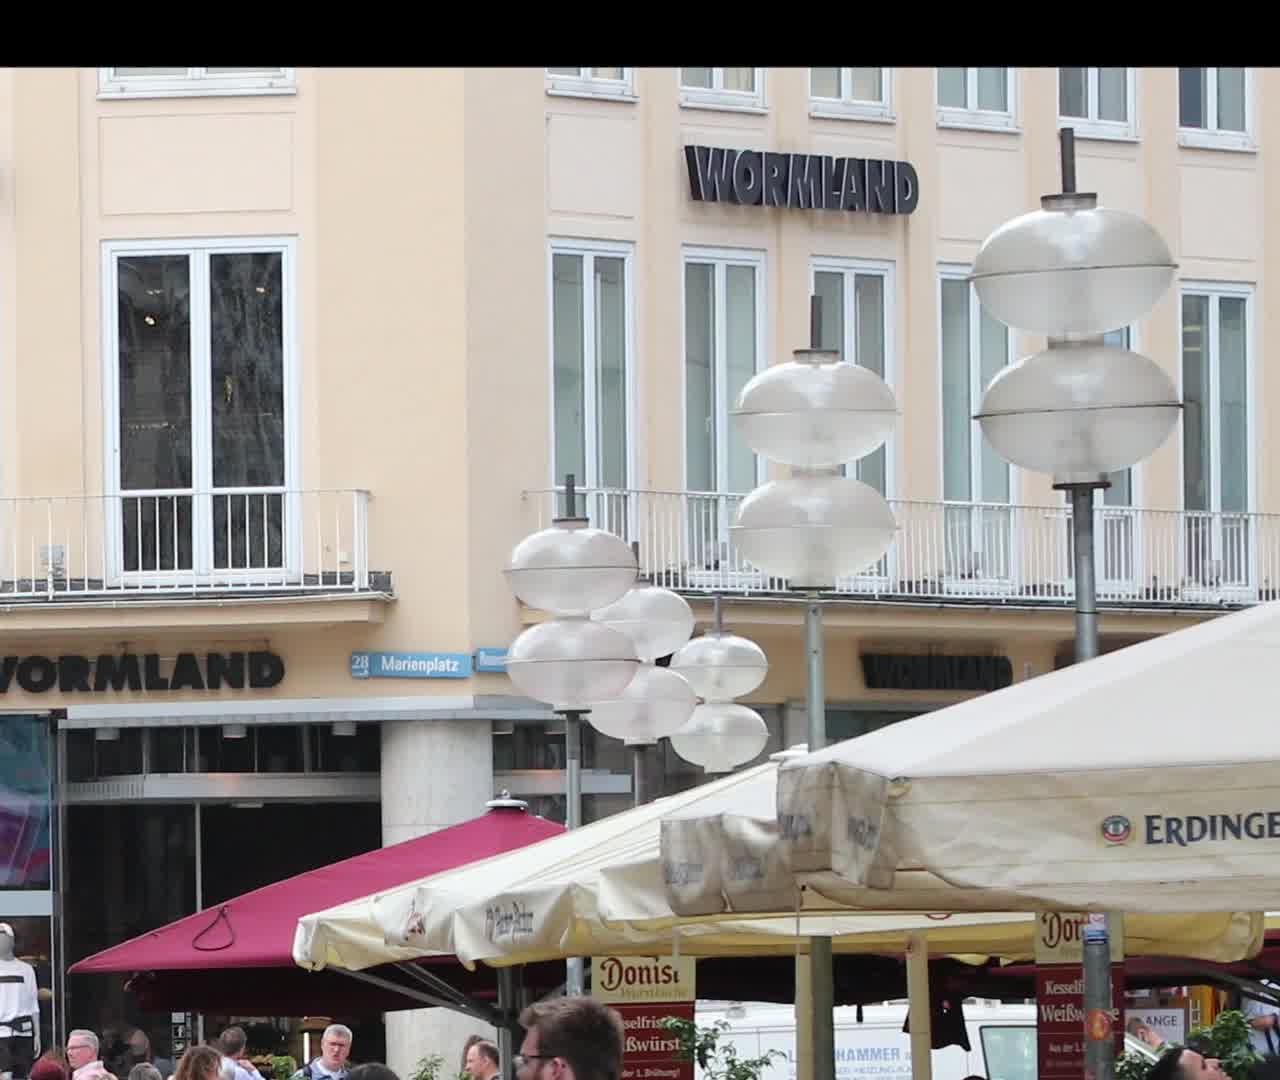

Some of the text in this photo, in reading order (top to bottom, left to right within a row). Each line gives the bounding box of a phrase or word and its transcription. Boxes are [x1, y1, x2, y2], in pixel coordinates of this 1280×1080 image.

[684, 145, 920, 215] WORMLAND
[352, 655, 459, 674] 28 Marienplatz
